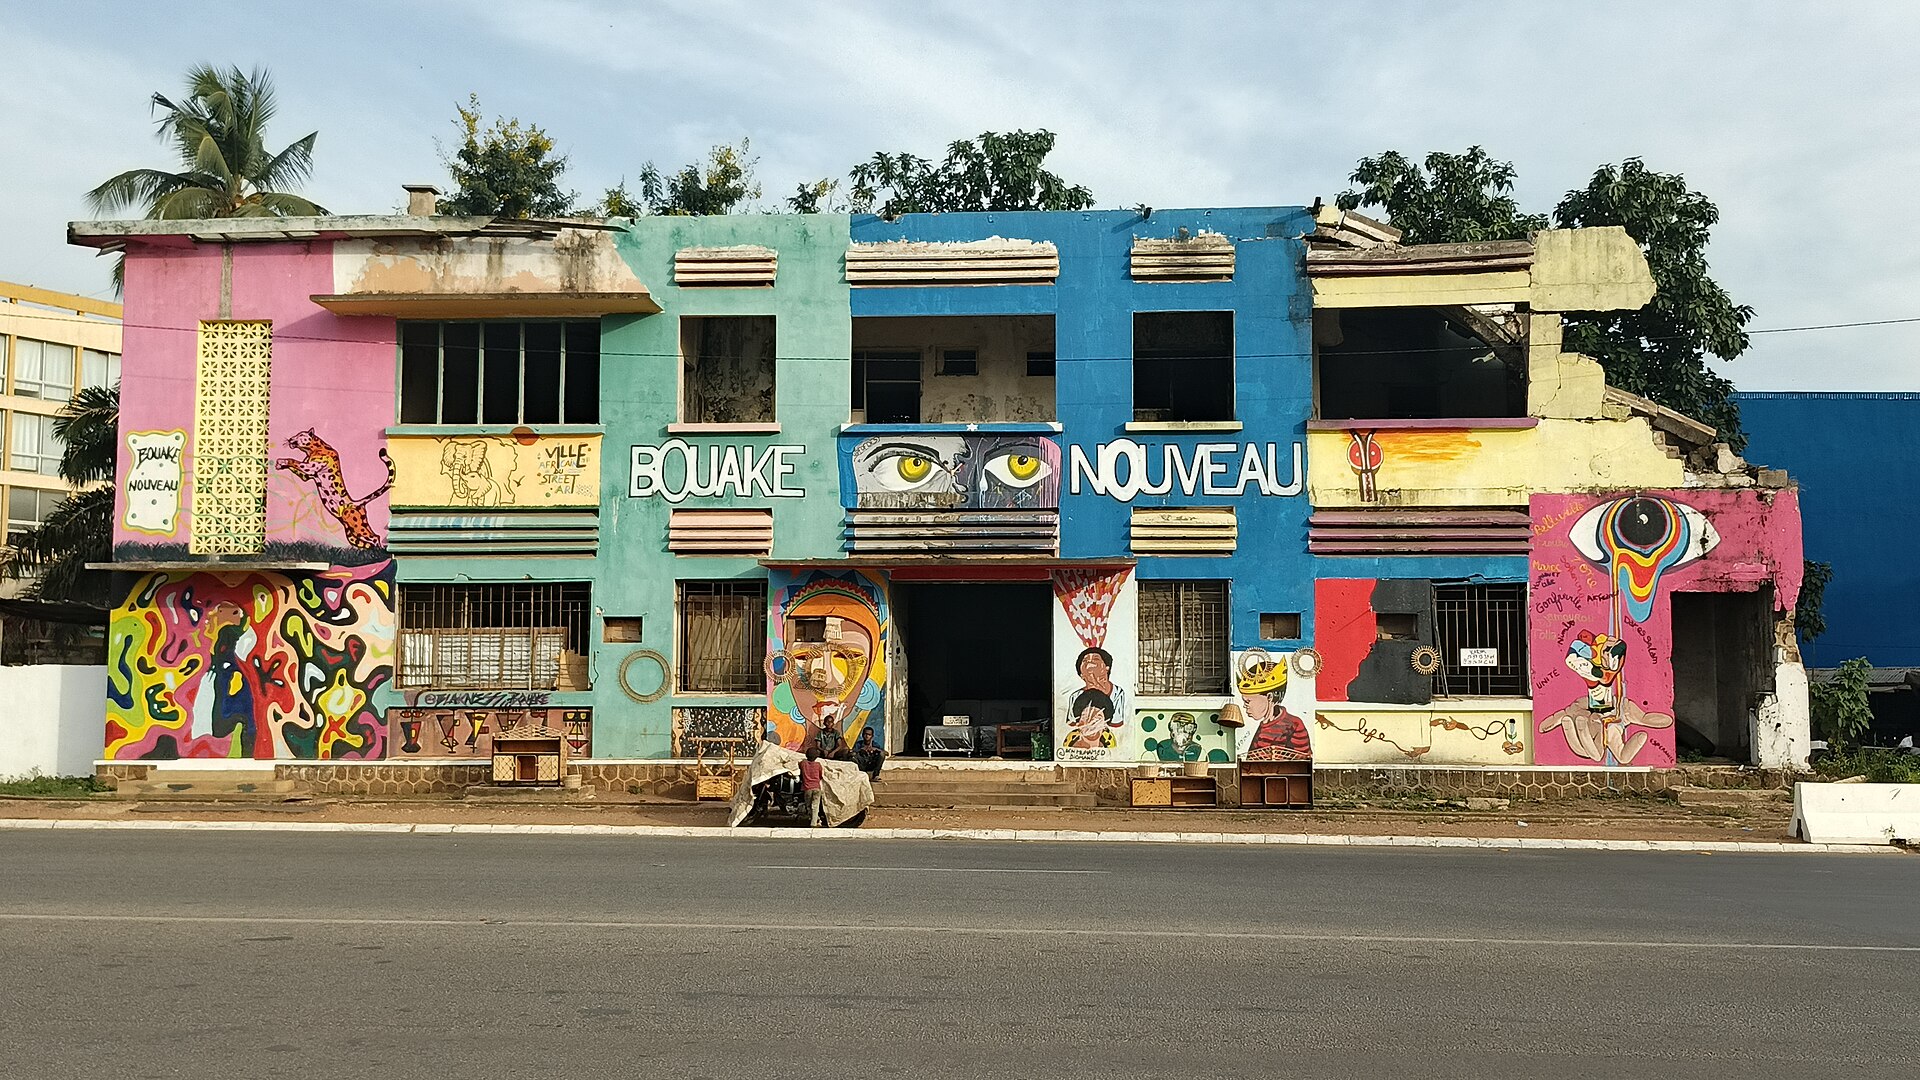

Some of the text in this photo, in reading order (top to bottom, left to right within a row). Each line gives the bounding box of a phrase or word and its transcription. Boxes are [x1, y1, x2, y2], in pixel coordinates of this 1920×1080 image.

[136, 446, 181, 469] BOUAKE
[545, 443, 589, 468] VILLE
[541, 474, 580, 489] STREET
[628, 438, 1303, 503] BOUAKE NOUVEAU
[128, 479, 179, 492] NOUVEAU
